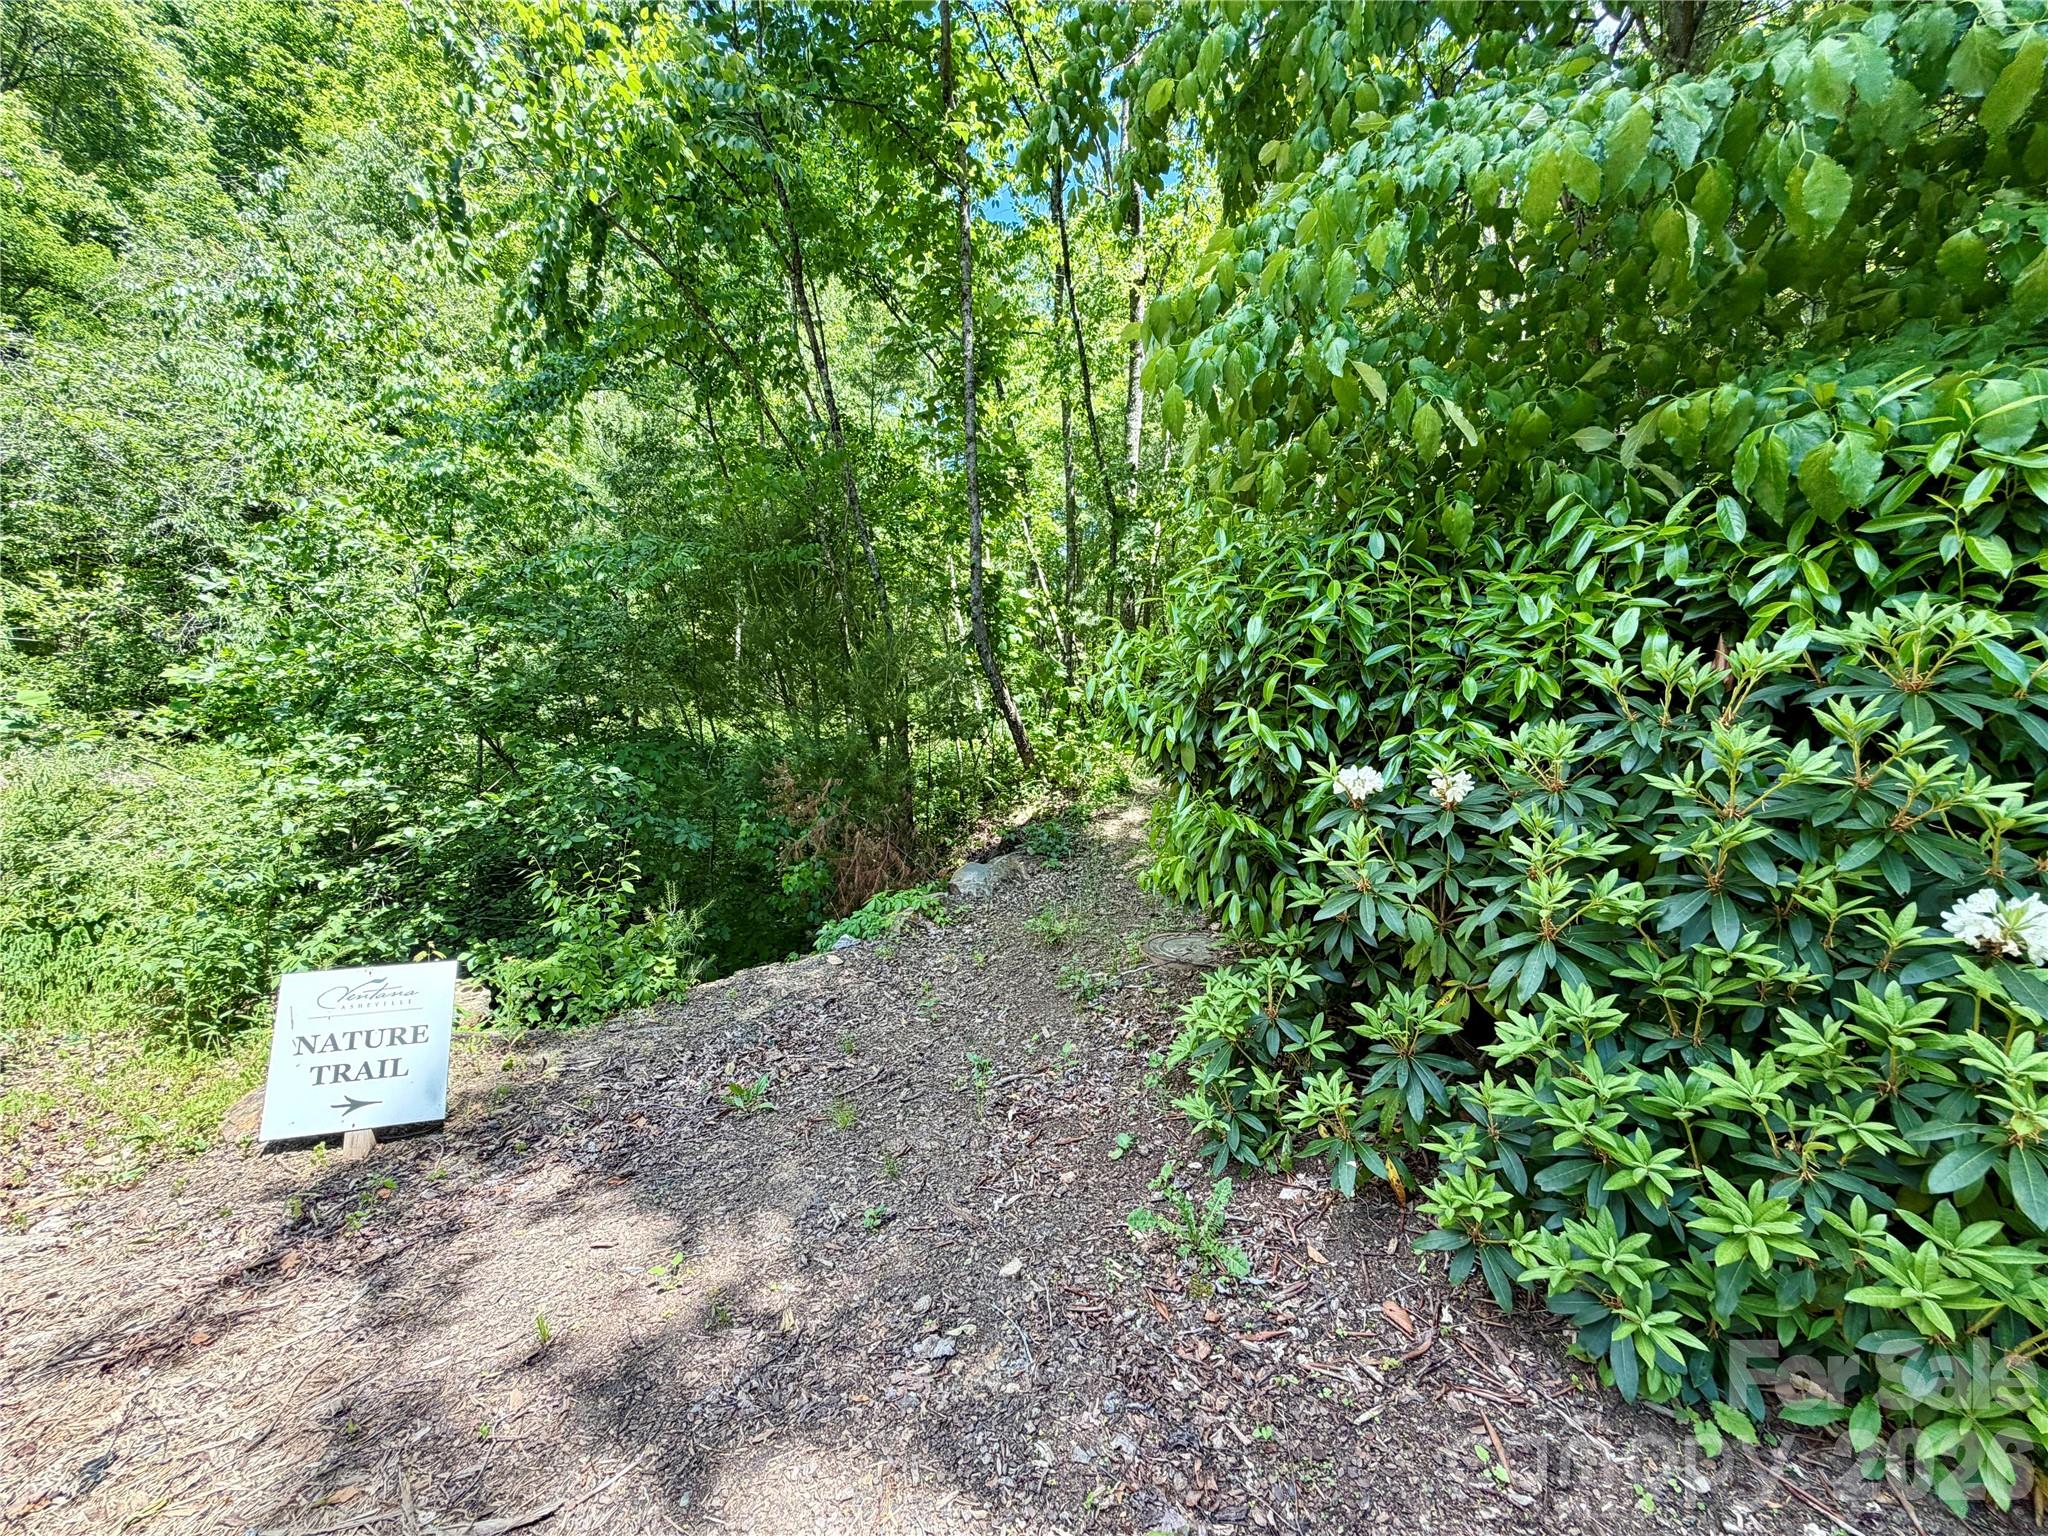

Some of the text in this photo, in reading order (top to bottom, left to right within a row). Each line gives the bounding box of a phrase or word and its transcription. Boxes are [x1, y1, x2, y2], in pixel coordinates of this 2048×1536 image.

[317, 977, 419, 1009] Ventana
[340, 998, 412, 1010] ASHEVILLE
[293, 1024, 429, 1056] NATURE
[309, 1058, 409, 1086] TRAIL
